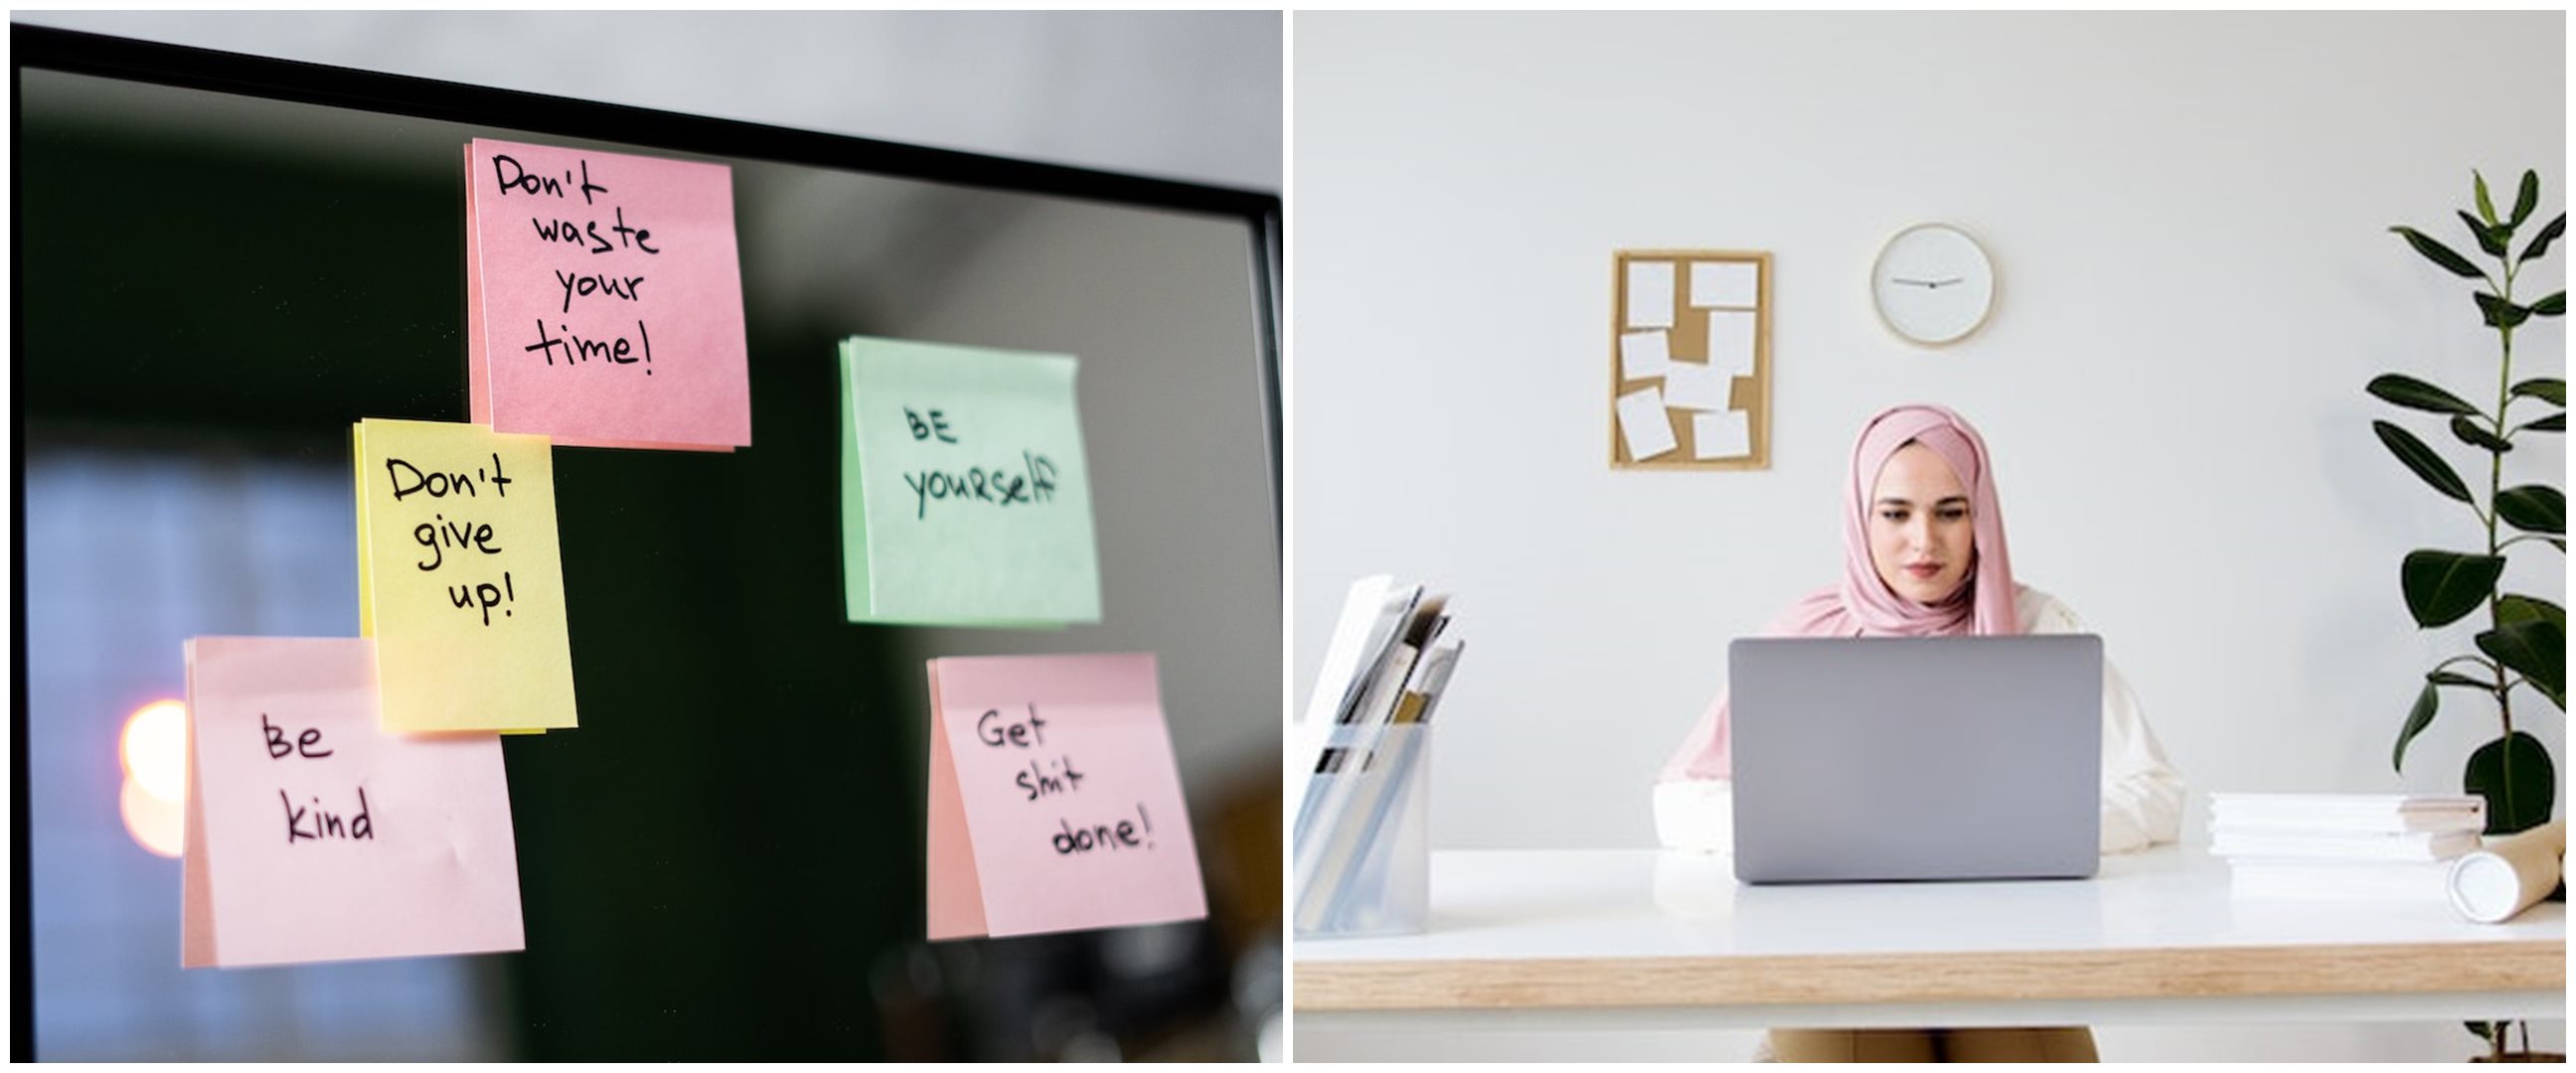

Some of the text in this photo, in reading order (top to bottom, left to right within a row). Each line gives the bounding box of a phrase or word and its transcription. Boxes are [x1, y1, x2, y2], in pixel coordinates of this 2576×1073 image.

[492, 154, 609, 206] Don't
[532, 206, 660, 255] waste
[555, 269, 645, 314] your
[524, 318, 653, 377] time!
[903, 405, 958, 445] BE
[385, 452, 513, 502] Don't
[412, 513, 502, 572] give
[447, 570, 515, 627] up!
[261, 712, 334, 760] Be
[977, 701, 1047, 747] Get
[279, 785, 375, 845] kind
[1051, 801, 1158, 856] done!
